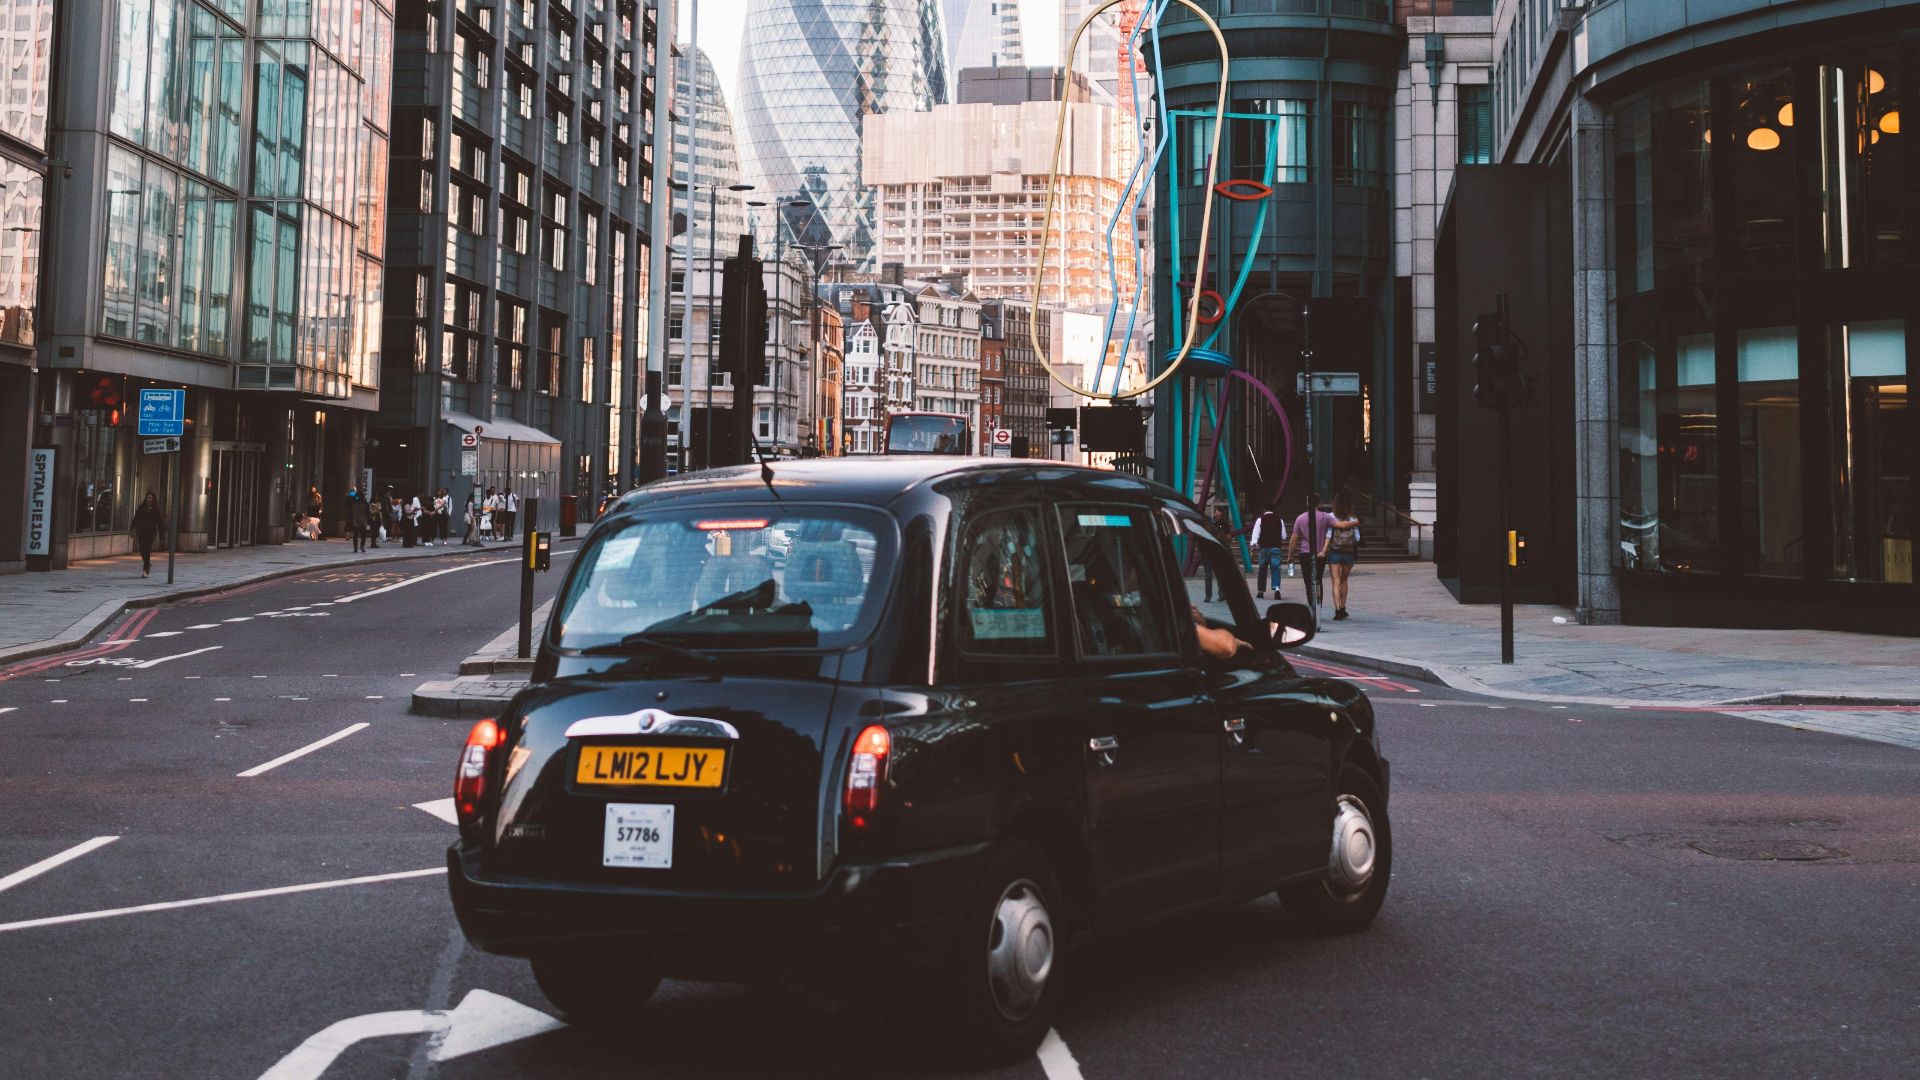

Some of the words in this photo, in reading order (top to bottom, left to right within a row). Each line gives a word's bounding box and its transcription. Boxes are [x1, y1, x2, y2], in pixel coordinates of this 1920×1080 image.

[594, 751, 650, 779] LM12
[655, 752, 708, 781] LJY
[617, 827, 660, 842] 57786
